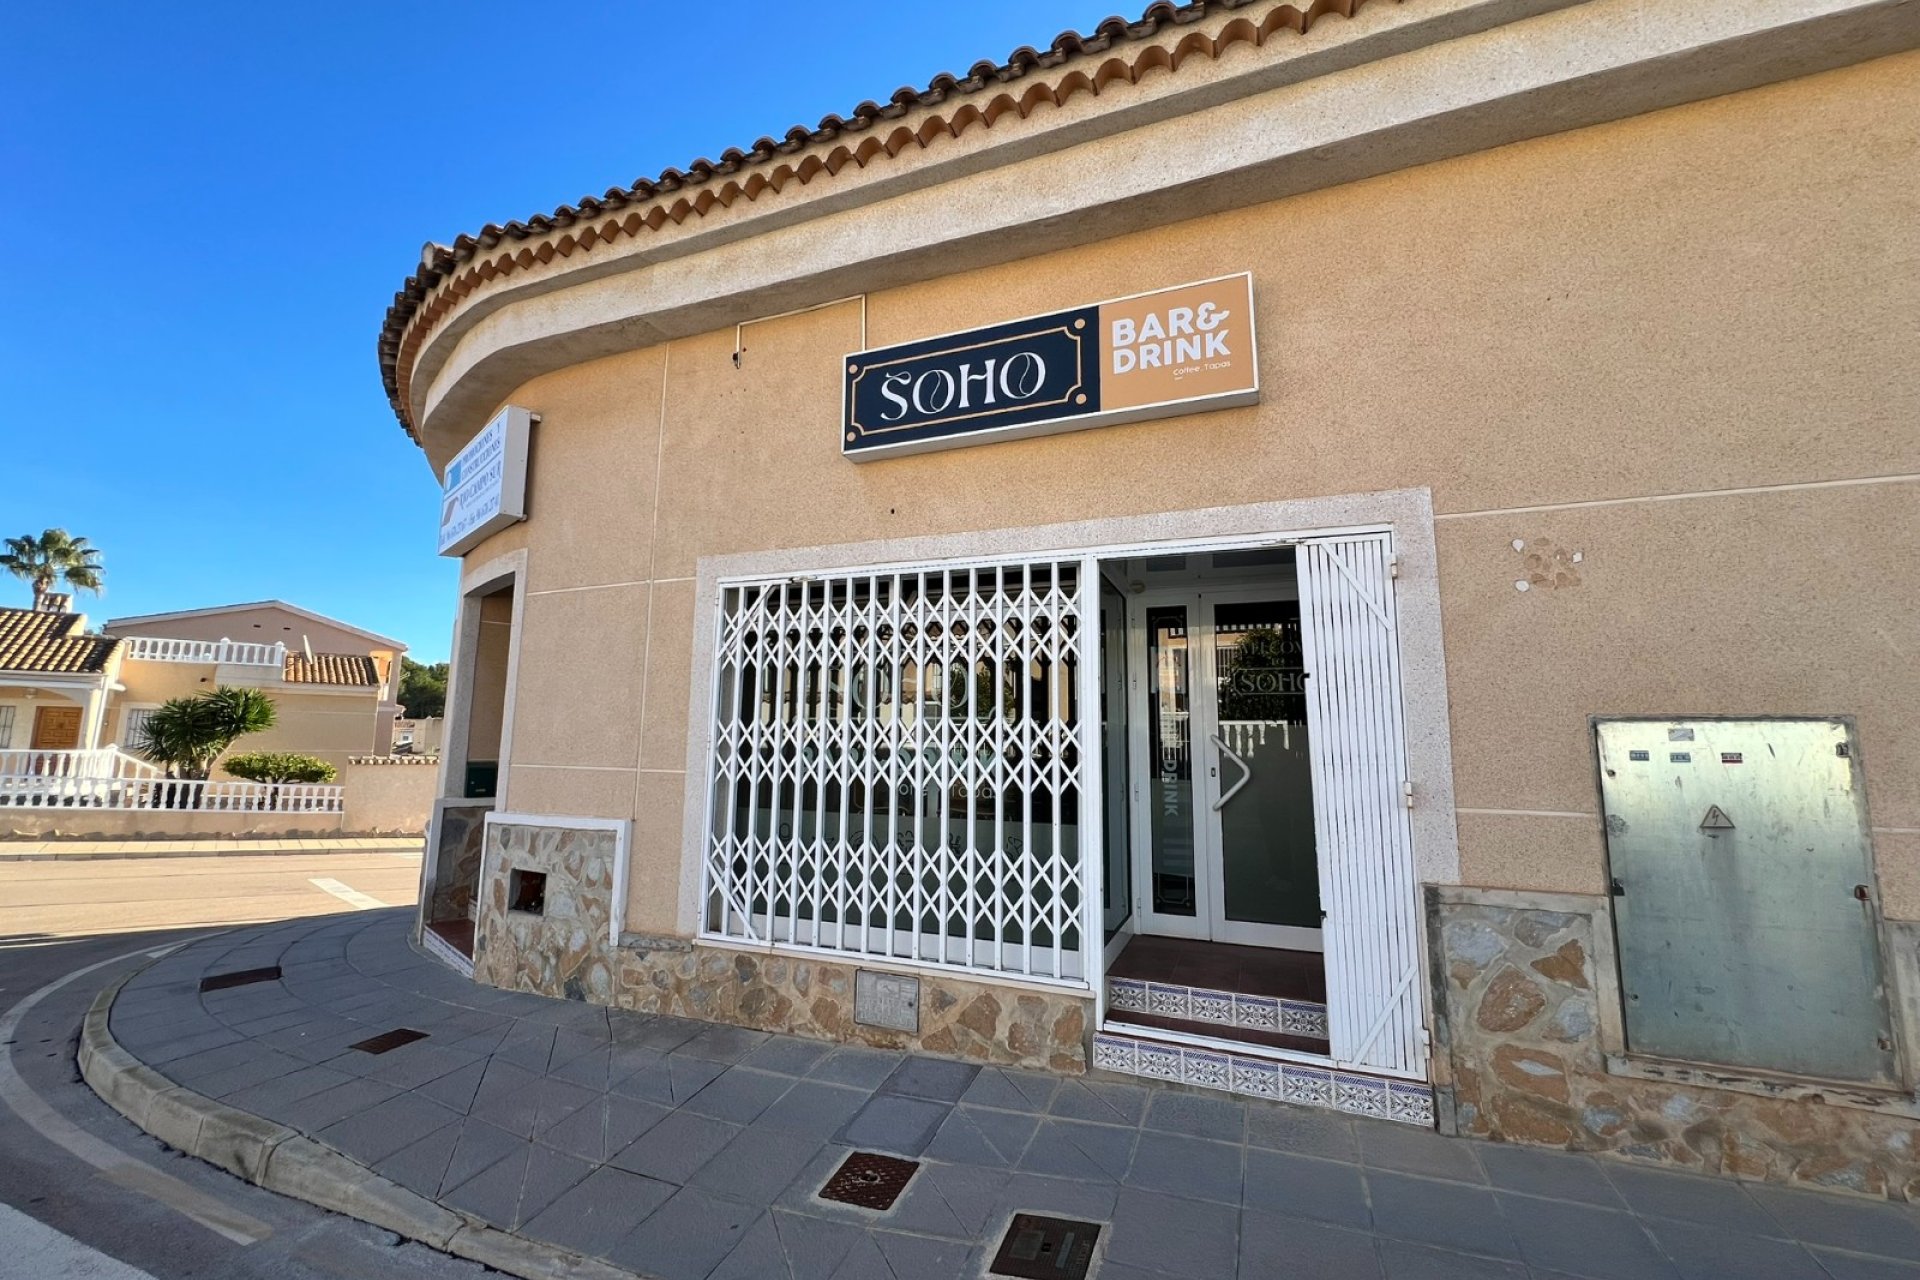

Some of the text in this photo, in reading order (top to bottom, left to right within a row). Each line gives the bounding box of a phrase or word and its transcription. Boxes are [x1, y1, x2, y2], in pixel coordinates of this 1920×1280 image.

[1113, 328, 1232, 375] DRINK
[1204, 361, 1232, 371] Tapas
[880, 351, 1046, 421] SOHO
[1163, 759, 1179, 816] DRINK
